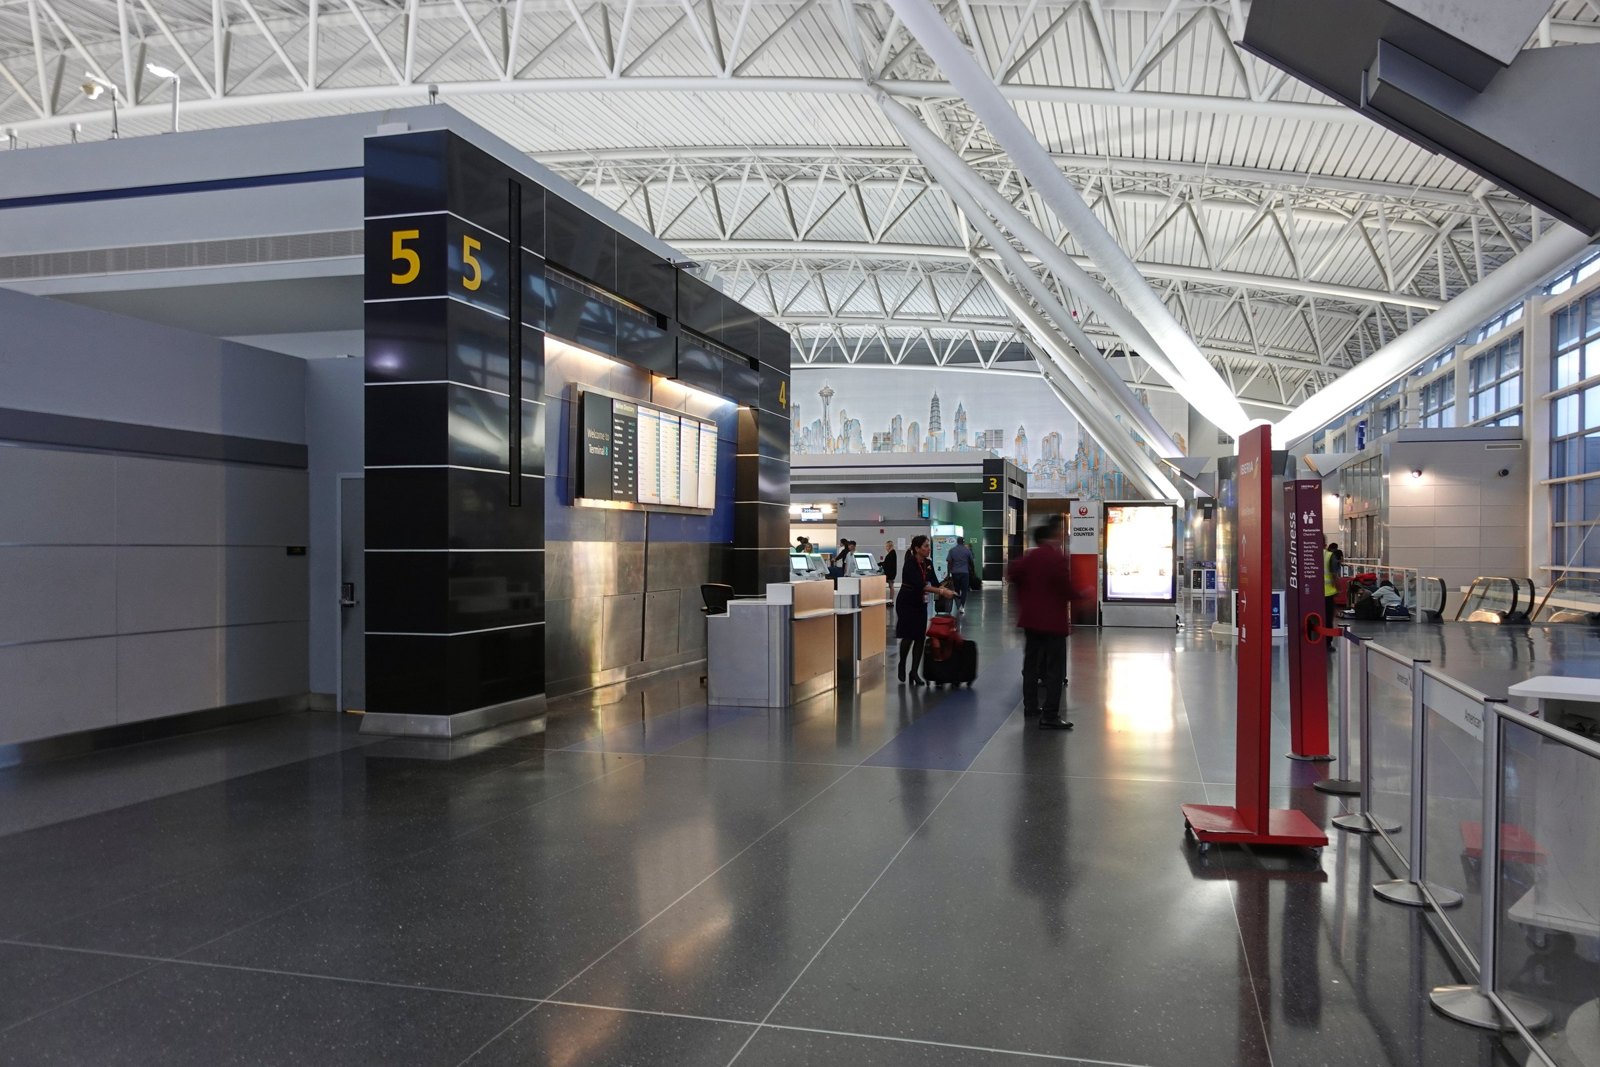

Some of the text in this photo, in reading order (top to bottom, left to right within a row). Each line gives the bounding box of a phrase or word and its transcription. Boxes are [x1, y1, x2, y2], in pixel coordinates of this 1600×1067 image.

[391, 229, 421, 285] 5
[462, 234, 482, 291] 5
[779, 380, 787, 409] 4
[587, 428, 604, 440] Welcome
[588, 443, 604, 456] Terminal
[989, 477, 998, 490] 3
[1289, 512, 1298, 589] Business
[1464, 708, 1482, 729] American
